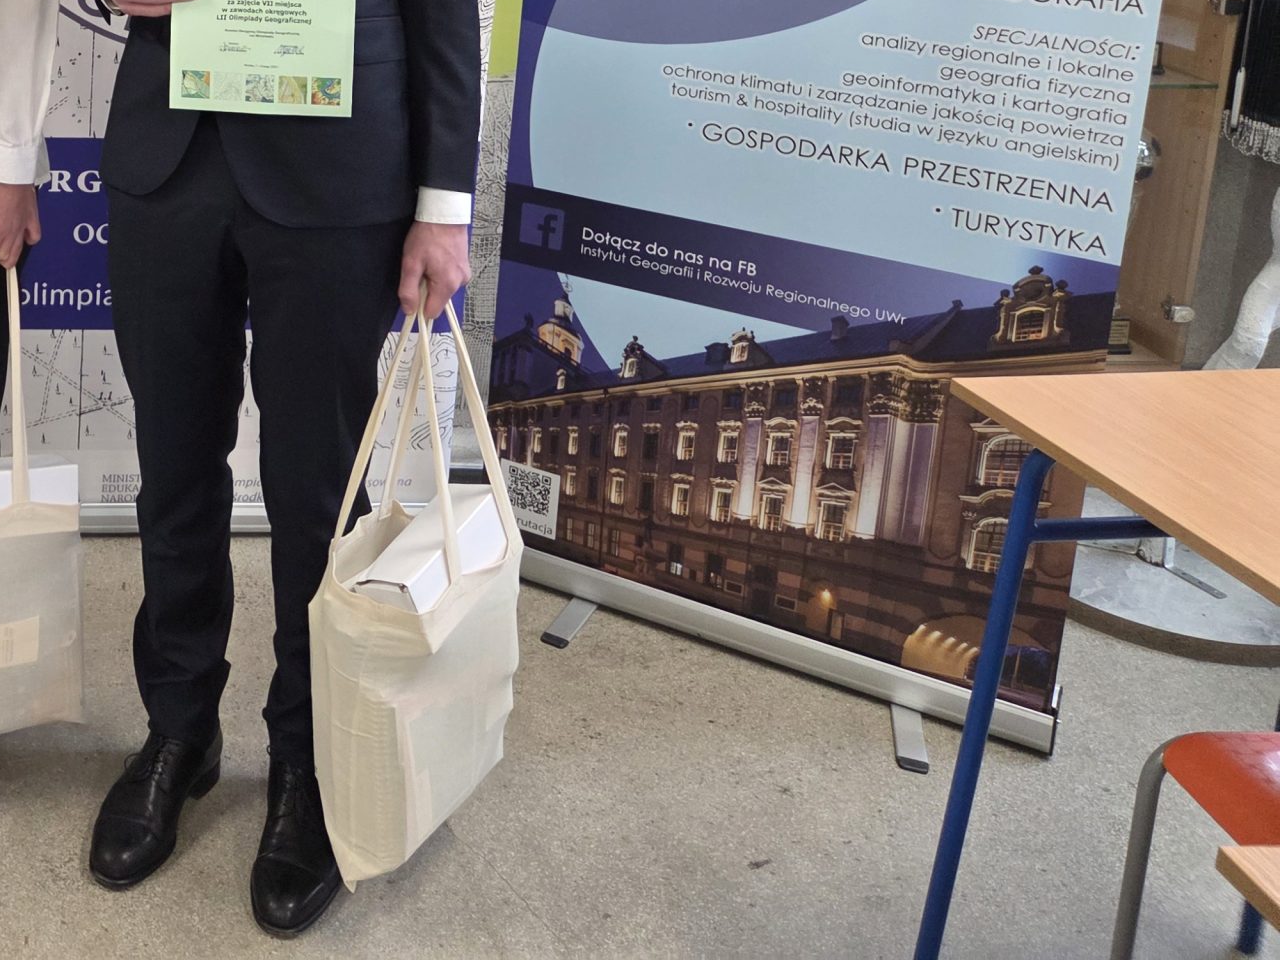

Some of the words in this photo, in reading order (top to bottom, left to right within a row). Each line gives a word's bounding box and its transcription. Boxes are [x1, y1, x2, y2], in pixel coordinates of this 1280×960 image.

[862, 34, 926, 55] analizy
[932, 42, 1040, 69] regionalne
[1047, 55, 1052, 71] i
[1058, 57, 1134, 82] lokalne
[974, 25, 1140, 61] SPECJALNOŚCI:
[663, 64, 734, 85] ochrona
[740, 73, 803, 96] klimatu
[808, 84, 812, 97] i
[817, 88, 928, 115] zarządzanie
[932, 103, 1014, 131] jakością
[1020, 119, 1124, 147] powietrza
[842, 71, 995, 106] geoinformatyka
[1002, 91, 1007, 107] i
[1012, 96, 1127, 125] kartografia
[940, 64, 1040, 90] geografia
[1047, 77, 1131, 104] fizyczna
[672, 82, 730, 104] tourism
[736, 94, 748, 107] &
[754, 95, 843, 125] hospitality
[849, 110, 911, 134] (studia
[917, 125, 933, 136] w
[937, 123, 998, 148] języku
[1004, 138, 1120, 171] angielskim)
[702, 121, 890, 172] GOSPODARKA
[903, 156, 1113, 213] PRZESTRZENNA
[581, 226, 641, 253] Dołącz
[646, 240, 669, 259] do
[674, 249, 703, 266] nas
[709, 257, 732, 272] na
[738, 260, 757, 277] FB
[951, 207, 1107, 256] TURYSTYKA
[580, 243, 626, 265] Instytut
[630, 253, 693, 280] Geografii
[696, 266, 700, 280] i
[704, 270, 762, 296] Rozwoju
[766, 283, 871, 319] Regionalnego
[875, 308, 907, 325] UWr
